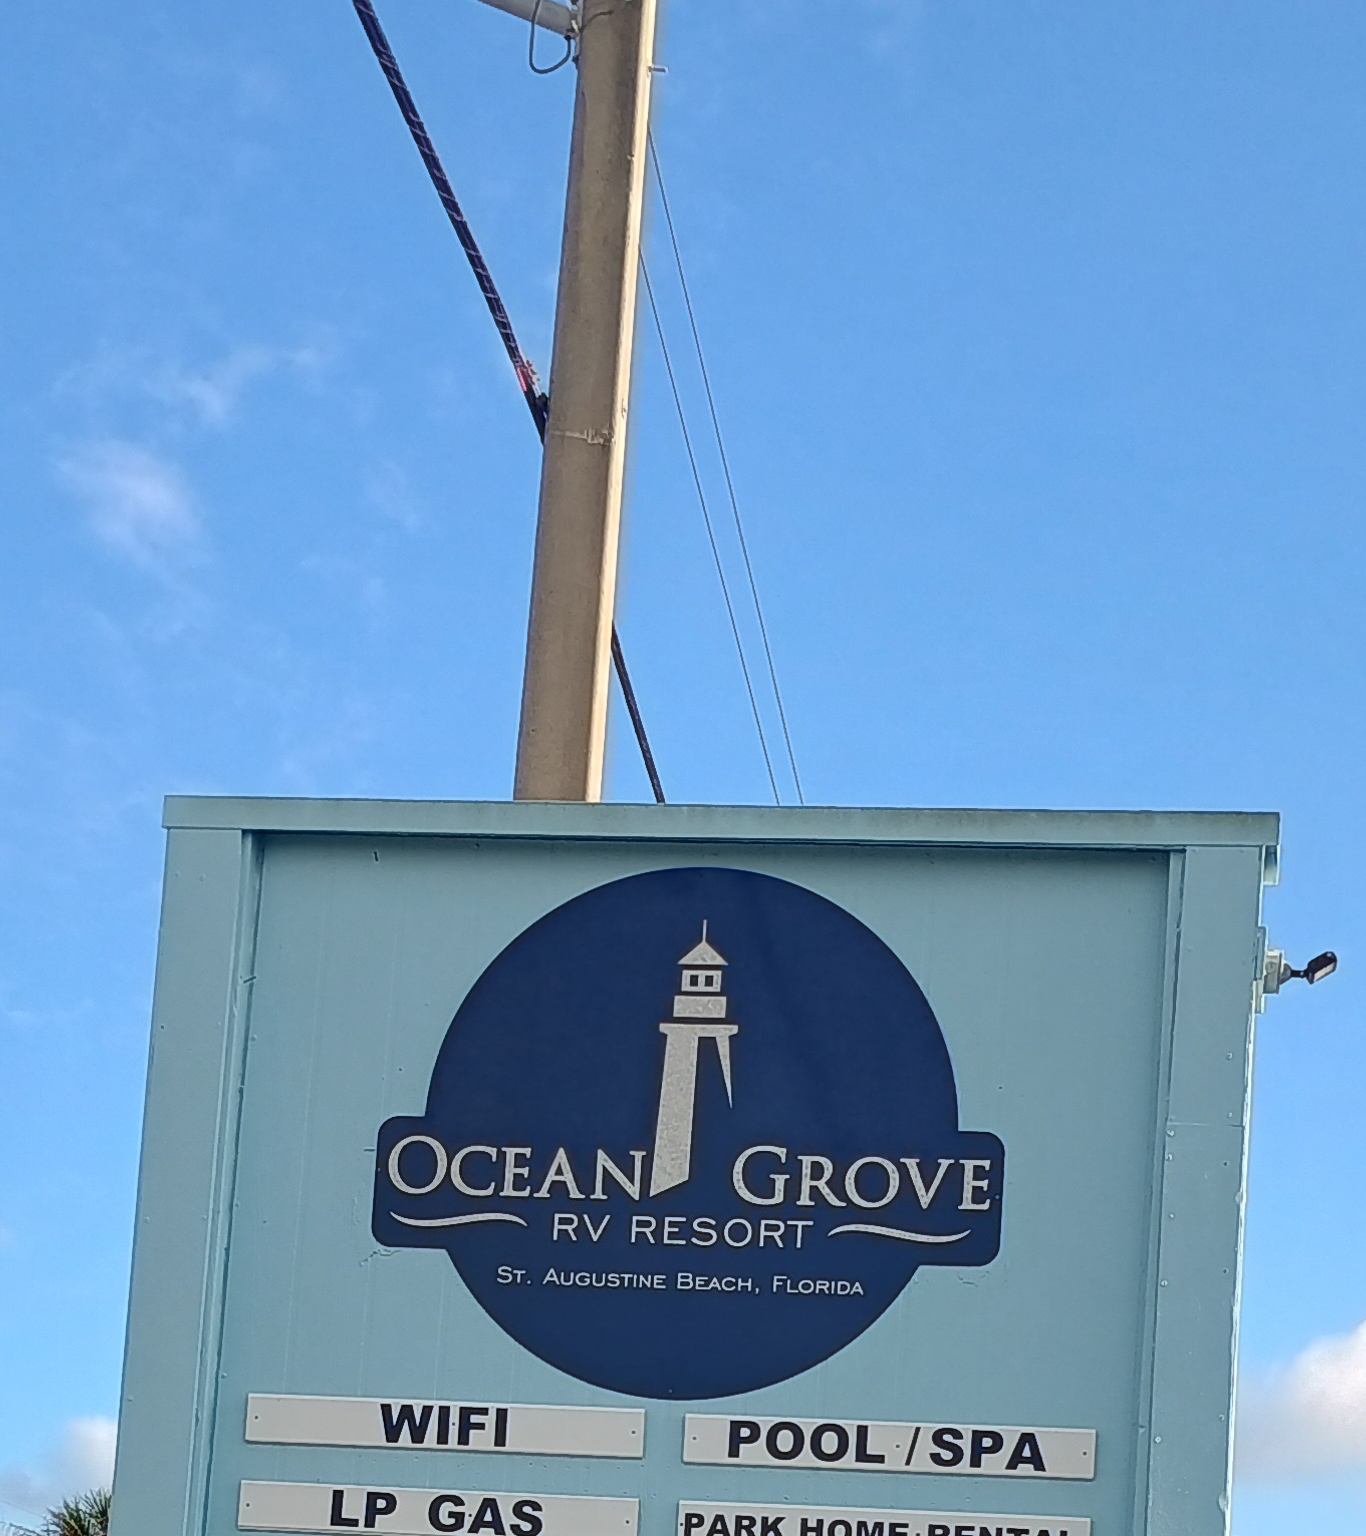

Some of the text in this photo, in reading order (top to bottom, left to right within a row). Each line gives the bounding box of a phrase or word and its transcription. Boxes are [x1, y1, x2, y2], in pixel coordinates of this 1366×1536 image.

[388, 1135, 992, 1211] OCEAN GROVE
[552, 1213, 814, 1249] RV RESORT
[542, 1268, 667, 1290] AUGUSTINE
[676, 1273, 760, 1295] BEACH,
[772, 1275, 865, 1296] FLORIDA
[380, 1403, 509, 1447] WIFI
[727, 1420, 886, 1465] POOL
[329, 1489, 398, 1529] LP
